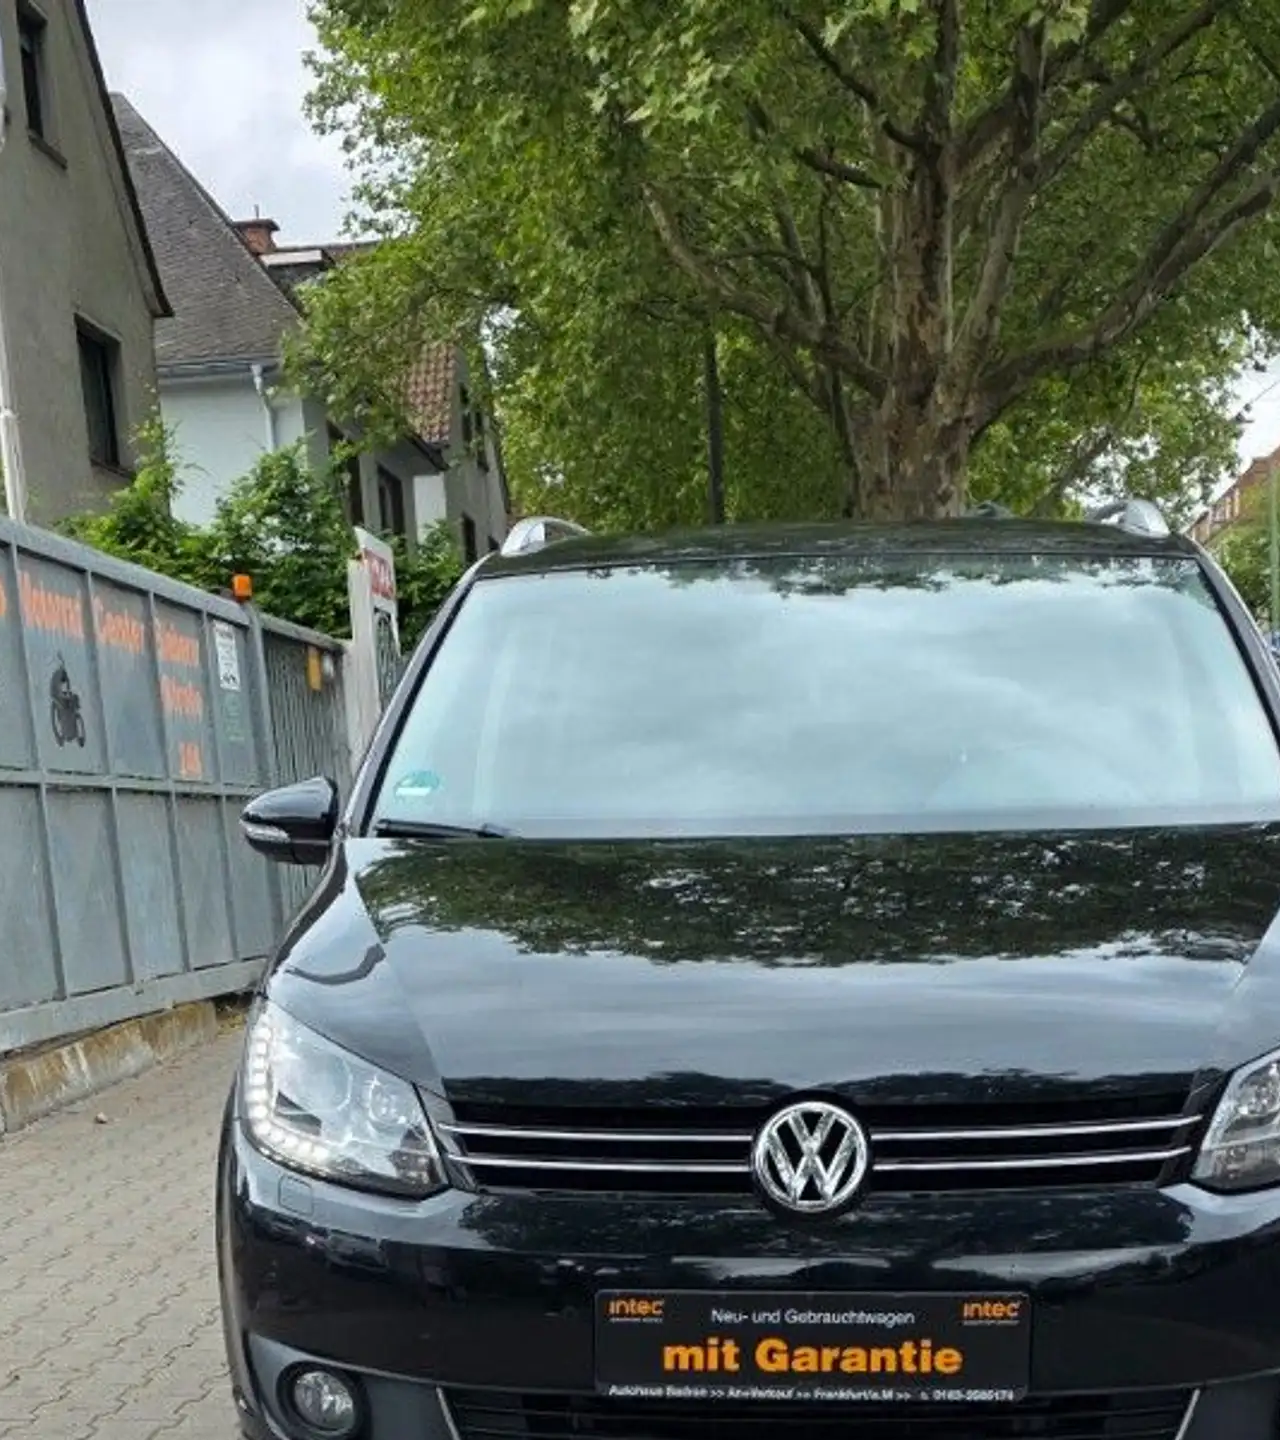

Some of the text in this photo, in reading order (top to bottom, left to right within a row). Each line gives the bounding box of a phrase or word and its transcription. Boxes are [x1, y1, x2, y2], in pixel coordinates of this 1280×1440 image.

[609, 1298, 665, 1315] intec
[963, 1301, 1021, 1317] intec
[711, 1308, 916, 1328] Neu- und Gebrauchtwagen
[663, 1337, 964, 1373] mit Garantie
